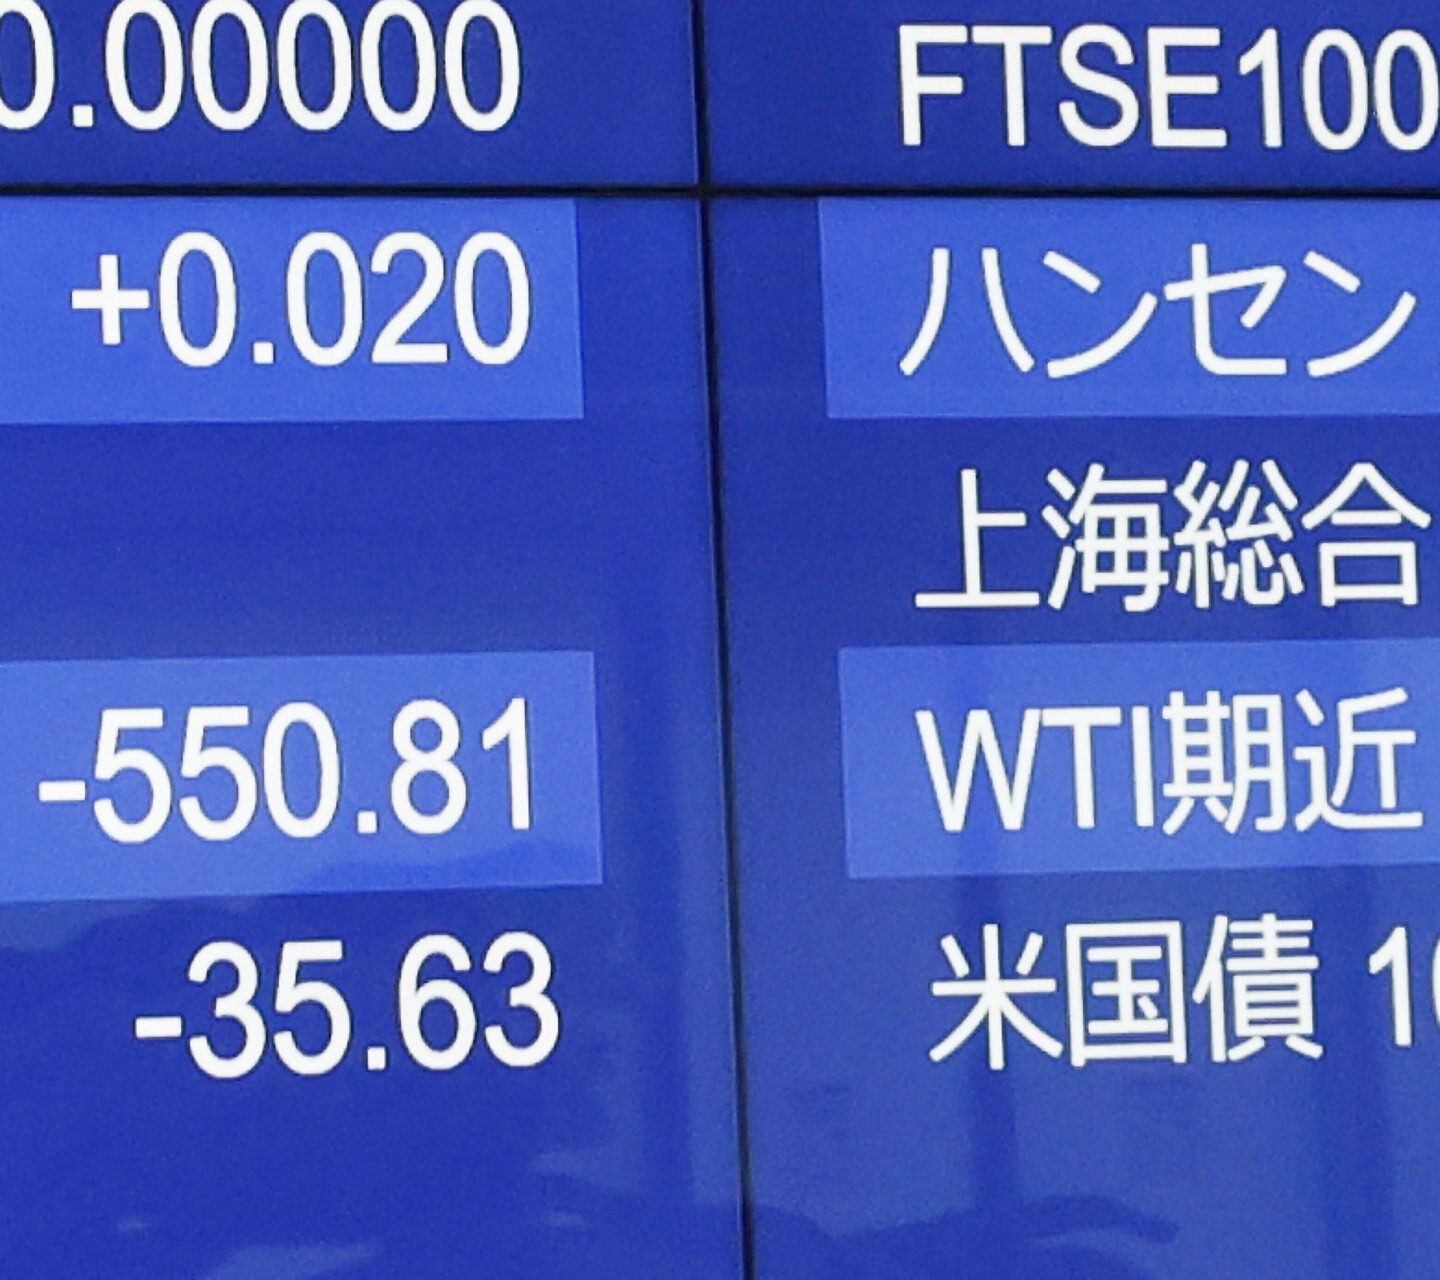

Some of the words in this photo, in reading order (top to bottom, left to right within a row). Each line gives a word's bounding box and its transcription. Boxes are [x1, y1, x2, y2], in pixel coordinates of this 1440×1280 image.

[898, 23, 1440, 152] FTSE100
[70, 230, 531, 368] +0.020
[898, 242, 1417, 379] ハンセン
[914, 458, 1432, 613] 上海総合
[37, 696, 531, 844] -550.81
[914, 686, 1424, 836] WTI期近
[134, 930, 560, 1079] -35.63
[928, 912, 1324, 1071] 米国債
